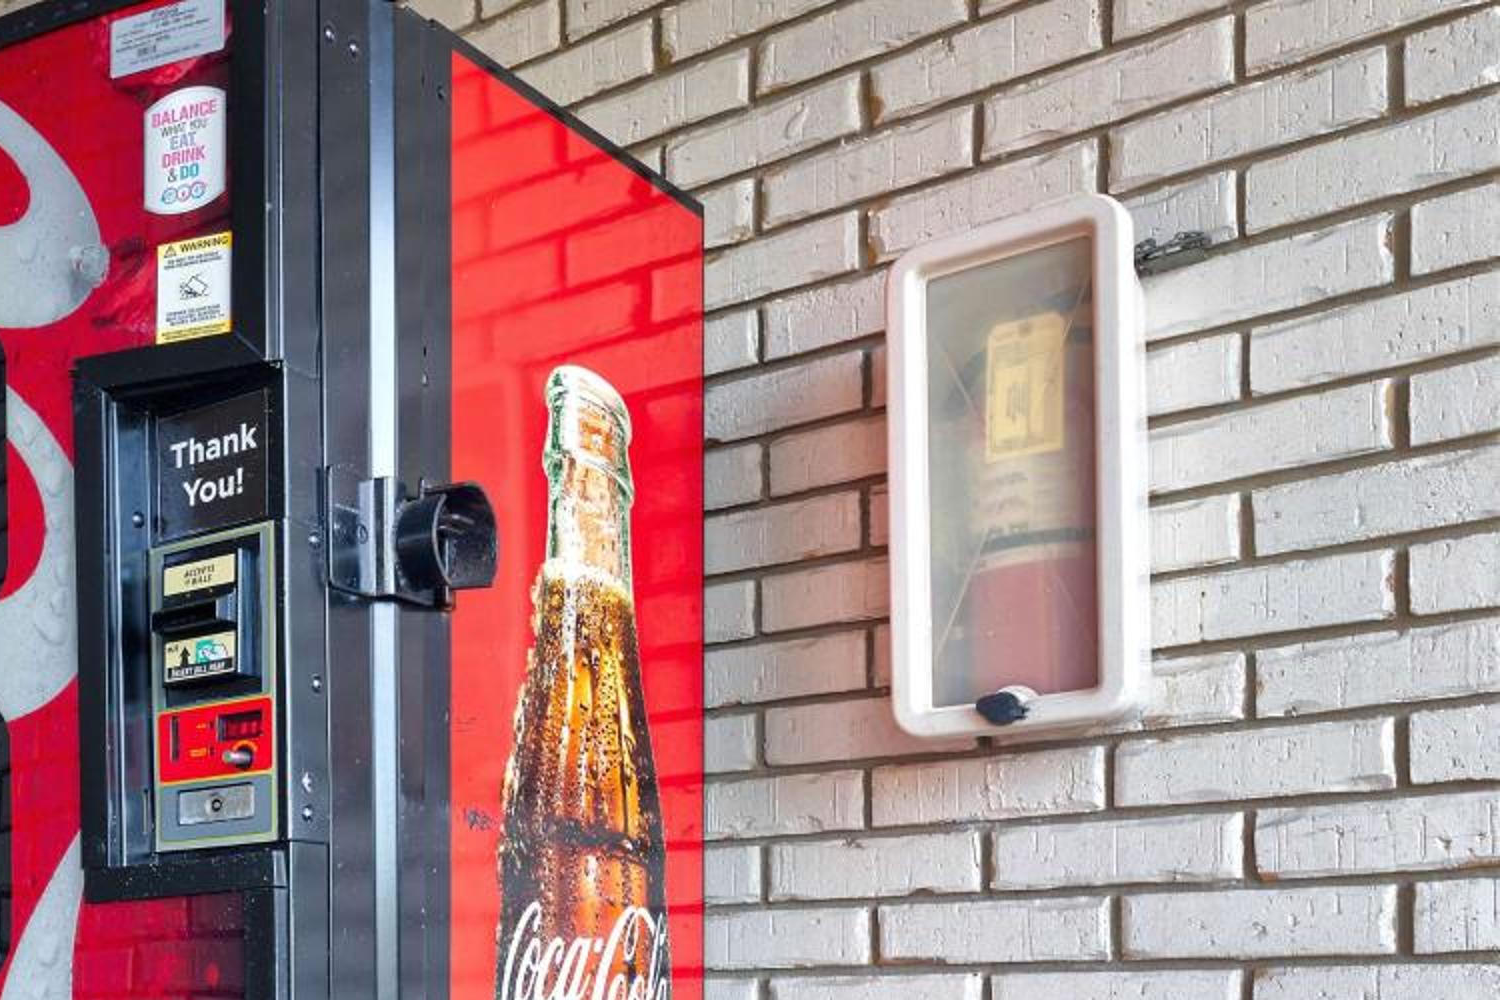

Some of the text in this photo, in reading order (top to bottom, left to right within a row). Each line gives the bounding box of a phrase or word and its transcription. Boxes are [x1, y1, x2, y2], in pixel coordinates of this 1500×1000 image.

[151, 98, 218, 129] BALANCE
[160, 118, 207, 138] WHAT YOU
[169, 131, 197, 150] EAT
[162, 145, 205, 169] DRINK
[167, 163, 199, 183] & DO
[180, 235, 229, 253] WARNING
[169, 422, 258, 469] Thank
[183, 467, 244, 507] You!
